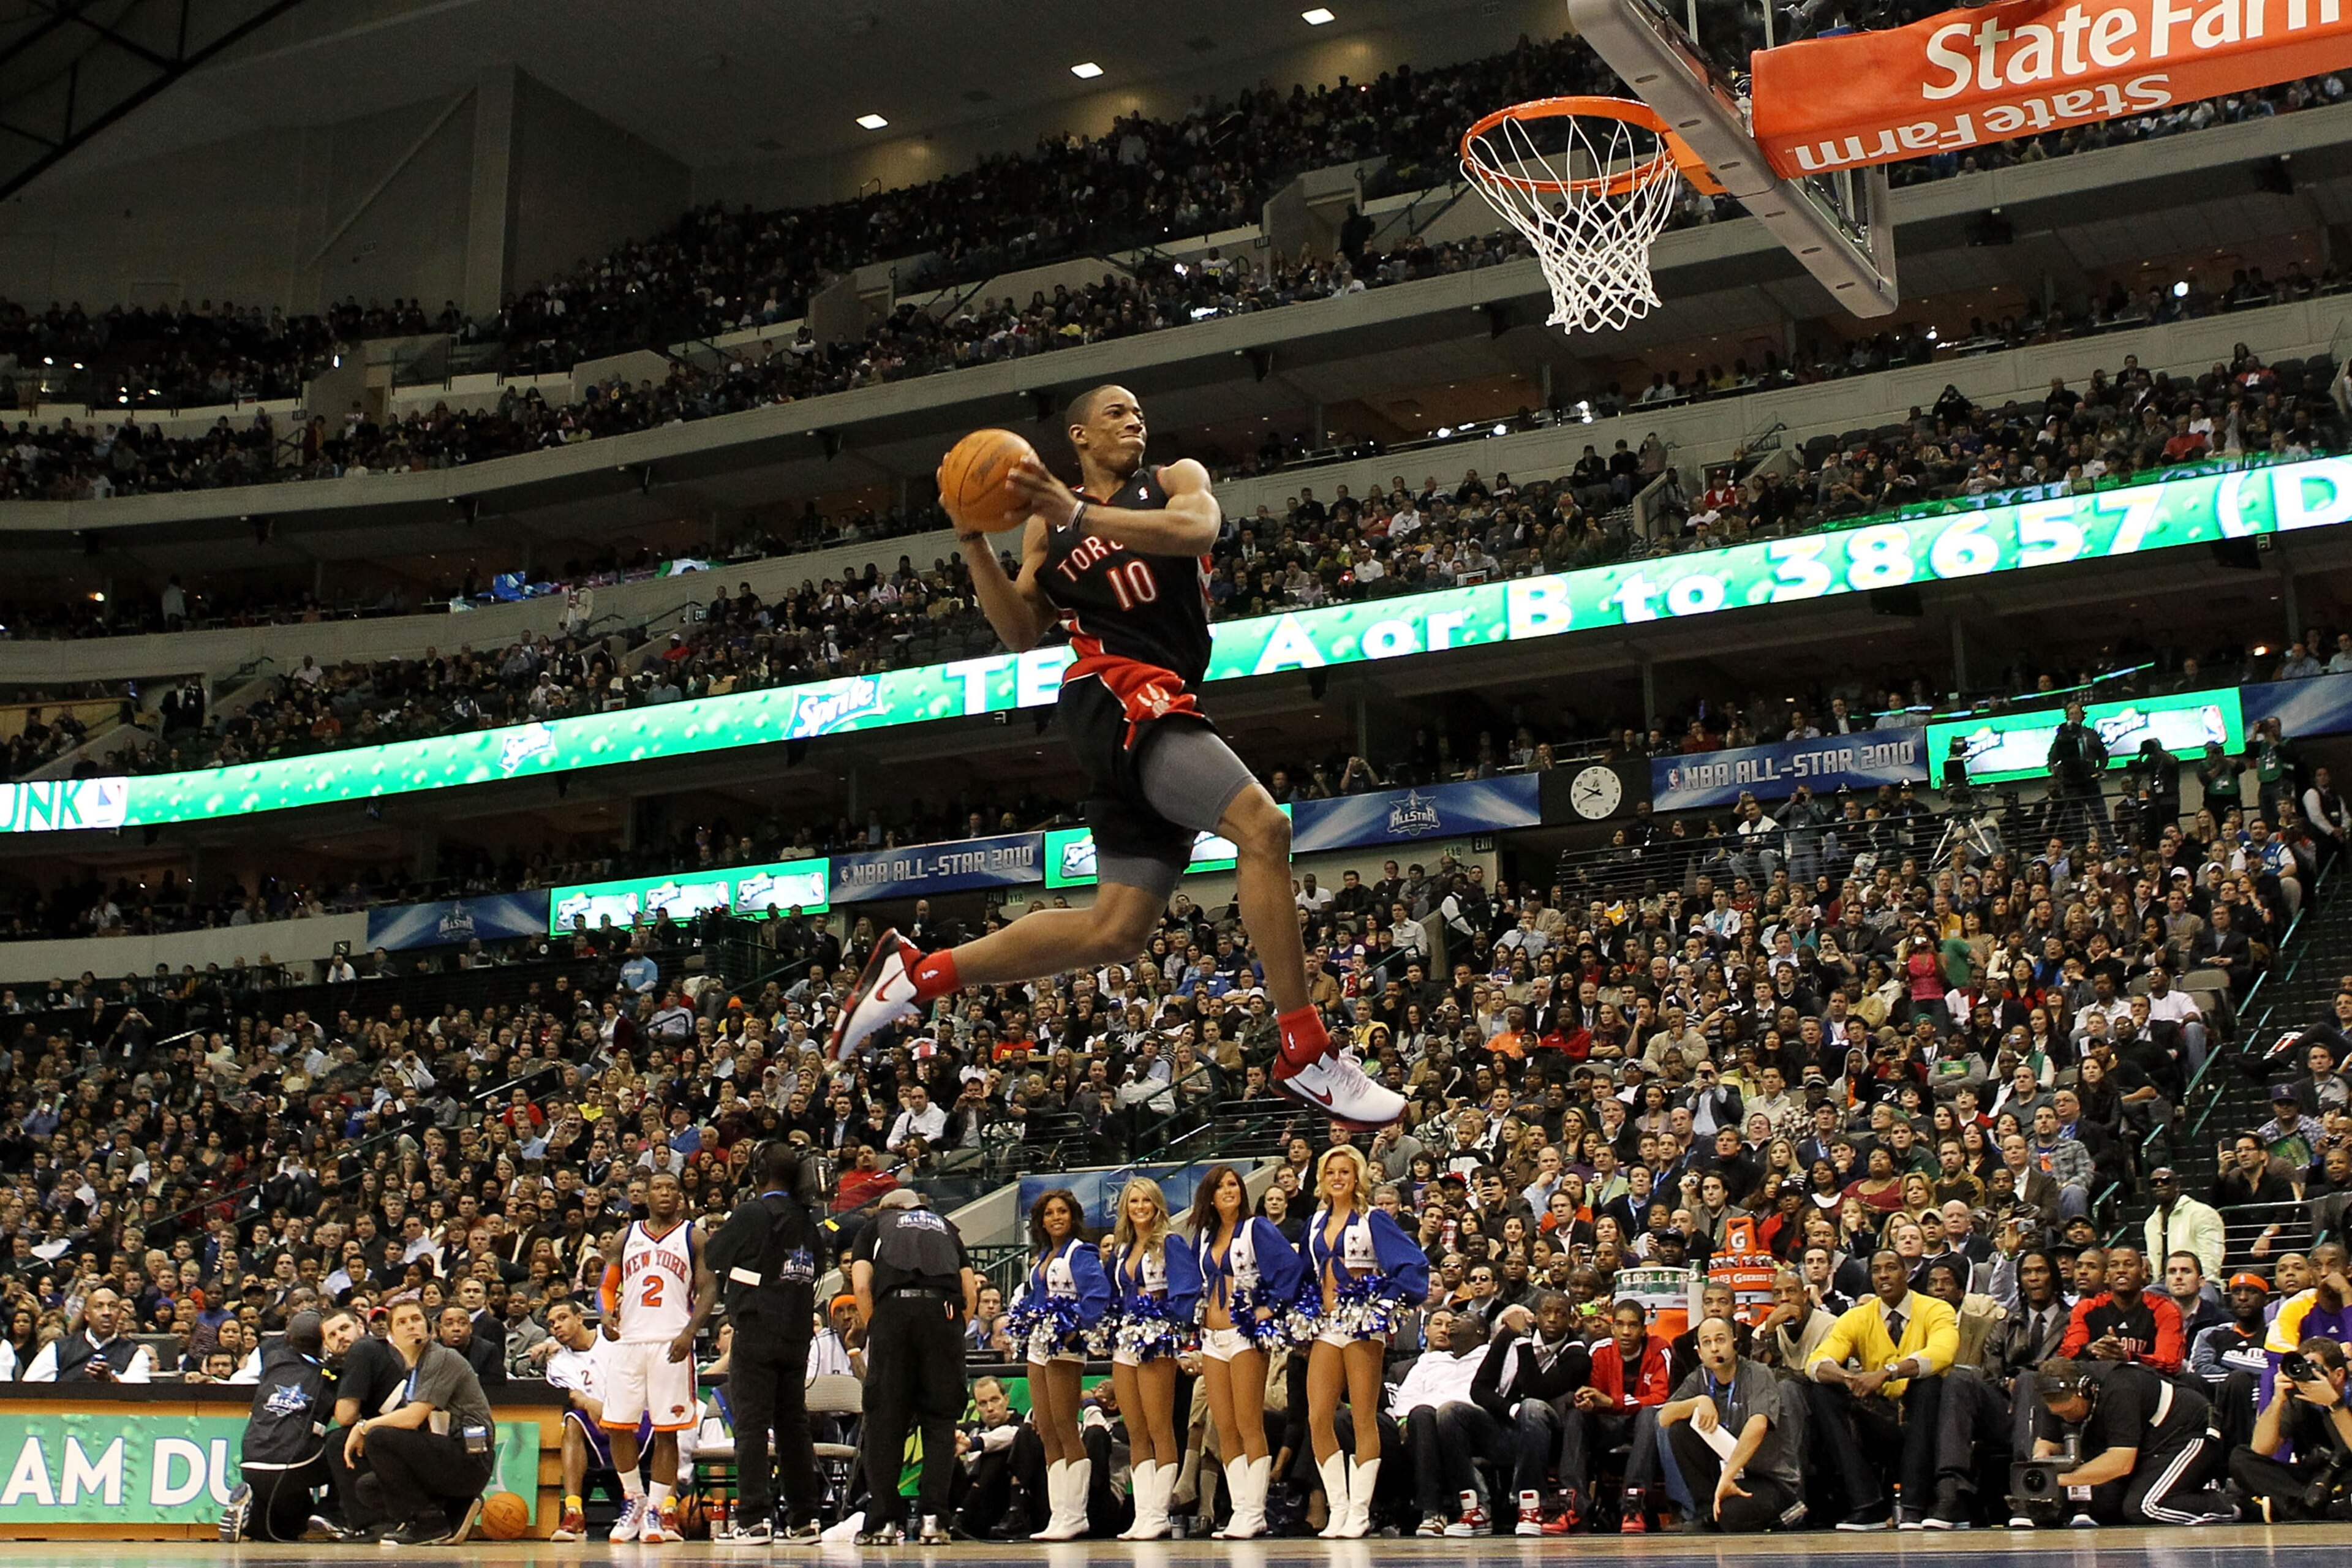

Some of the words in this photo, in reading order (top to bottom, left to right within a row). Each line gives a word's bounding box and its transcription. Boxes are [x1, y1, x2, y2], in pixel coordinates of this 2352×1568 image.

[1922, 4, 2138, 100] State
[1983, 74, 2173, 129] State
[1795, 113, 1978, 170] Farm
[1104, 557, 1160, 612] 10
[1253, 611, 1327, 676] A
[1360, 610, 1466, 662] or
[1507, 573, 1572, 641] B
[1613, 570, 1725, 624] to
[1768, 483, 2167, 603] 38657
[792, 675, 875, 737] Sprite
[2100, 712, 2147, 744] Sprite
[1684, 763, 1728, 790] NBA
[1736, 747, 1853, 783] ALL-STAR
[1860, 741, 1915, 770] 2010
[852, 861, 888, 886] NBA
[893, 851, 986, 881] ALL-STAR
[991, 845, 1034, 870] 2010
[1475, 837, 1493, 851] EXIT
[1730, 1231, 1746, 1249] G
[624, 1250, 651, 1281] NEW
[655, 1249, 687, 1284] YORK
[641, 1275, 664, 1308] 2
[581, 1370, 592, 1385] 2
[0, 1435, 124, 1506] AM
